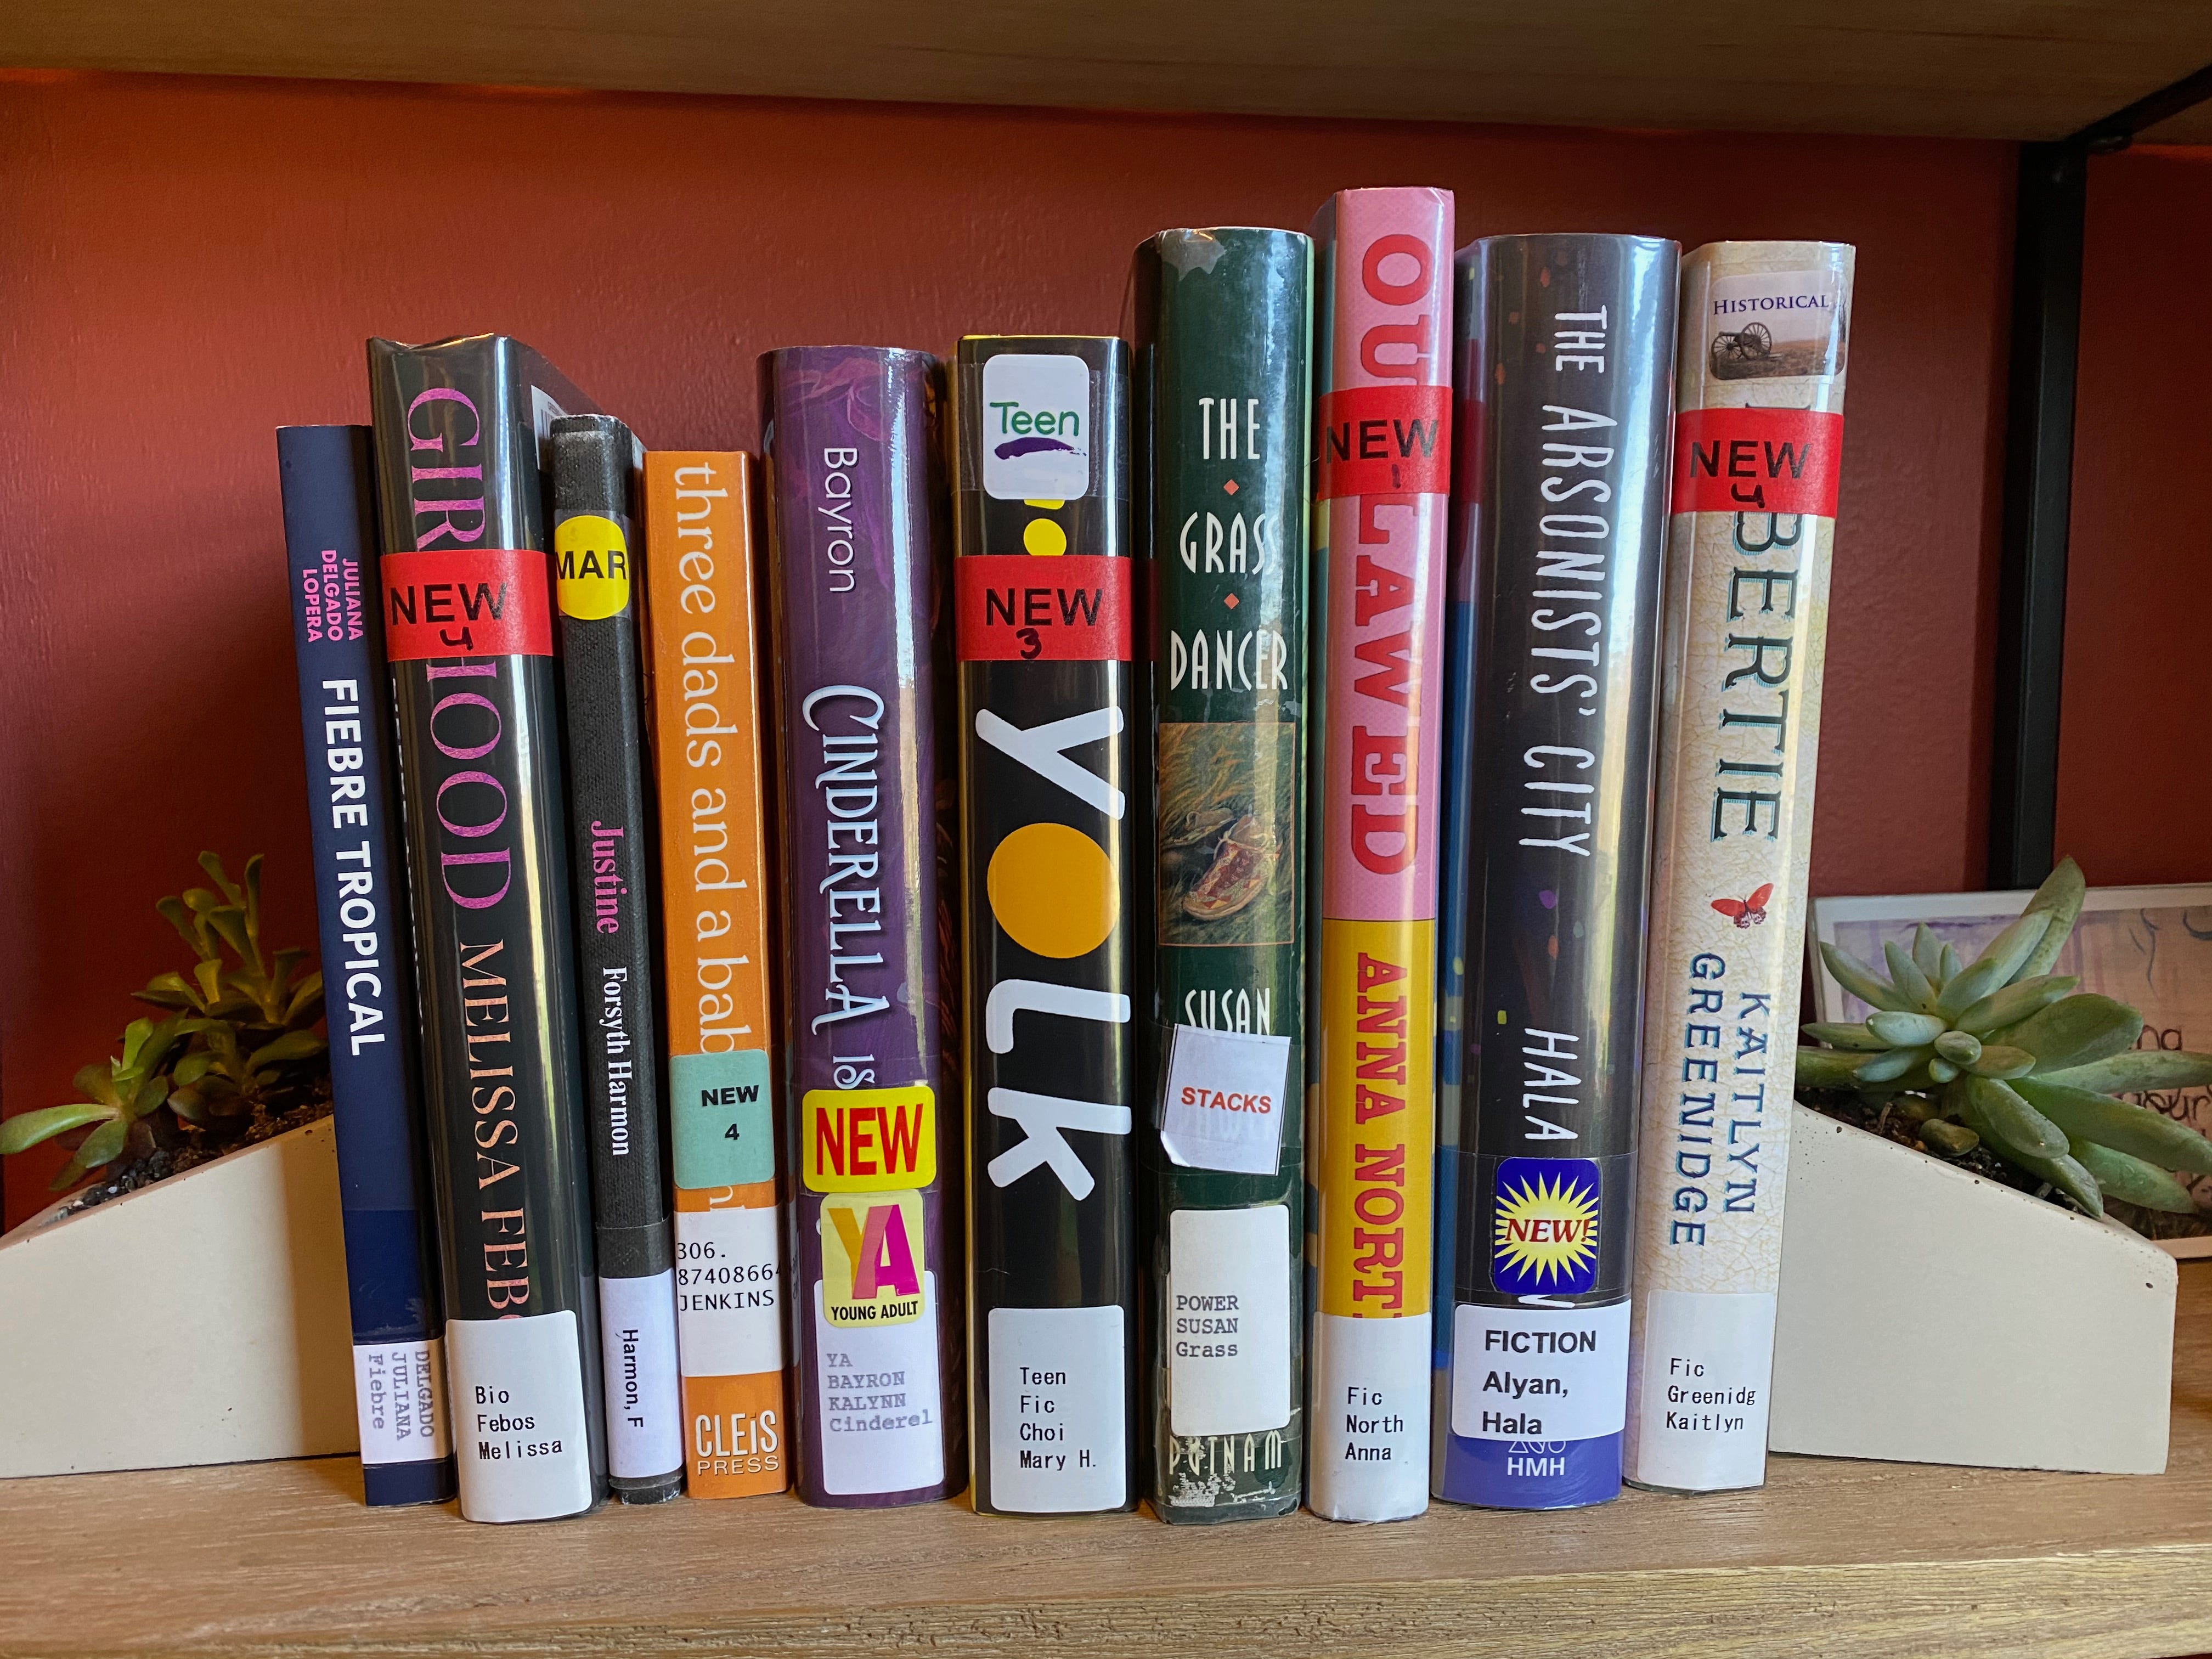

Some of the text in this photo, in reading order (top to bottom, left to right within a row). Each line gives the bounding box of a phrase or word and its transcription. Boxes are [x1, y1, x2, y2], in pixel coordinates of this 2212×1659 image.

[1554, 304, 1607, 374] THE
[990, 401, 1080, 436] Teen
[1199, 398, 1260, 460] THE
[1326, 419, 1438, 462] NEW
[1690, 439, 1811, 479] NEW
[818, 448, 857, 592] Bayron
[1180, 511, 1278, 574] GRASS
[1351, 234, 1434, 875] OULAWED
[555, 550, 628, 582] MAR
[303, 569, 323, 643] LOPERA
[321, 550, 343, 641] DELGADO
[342, 558, 364, 641] JULIANA
[391, 582, 507, 625] NEW
[986, 588, 1103, 627] NEW
[1711, 402, 1810, 842] BERTIE
[407, 388, 511, 909] GIROOD
[1015, 628, 1042, 659] 3
[1171, 629, 1288, 691] DANCER
[674, 462, 752, 1053] three dads and a bab
[1518, 744, 1595, 857] CITY
[322, 679, 386, 1056] FIEBRE TROPICAL
[590, 820, 628, 934] Justine
[802, 685, 890, 1036] CINDERELLA
[1184, 988, 1270, 1035] SUSAN
[599, 966, 632, 1156] Forsyth Harmon
[702, 1085, 759, 1107] NEW
[1521, 1026, 1580, 1141] HALA
[1670, 952, 1726, 1248] GREENIDGE
[1181, 1086, 1272, 1115] STACKS
[1722, 992, 1771, 1213] KAITLYN
[460, 939, 529, 1319] MELISSA FEB
[725, 1124, 740, 1141] 4
[816, 1103, 923, 1176] NEW
[1353, 952, 1408, 1318] ANNA NORT
[1505, 1218, 1592, 1243] NEW!
[678, 1242, 726, 1260] 306.
[827, 1204, 920, 1300] YA
[680, 1289, 774, 1311] JENKINS
[831, 1301, 919, 1322] YOUNG ADULT
[1177, 1295, 1239, 1311] POWER
[1177, 1318, 1238, 1334] SUSAN
[1485, 1330, 1596, 1354] FICTION
[826, 1353, 853, 1368] YA
[1176, 1341, 1238, 1357] Grass
[622, 1329, 644, 1427] Harmon, F
[827, 1372, 905, 1389] BAYRON
[1020, 1367, 1066, 1385] Teen
[1670, 1357, 1704, 1376] Fic
[369, 1353, 384, 1430] Fiebre
[392, 1352, 411, 1440] JULIANA
[415, 1351, 434, 1437] DELGADO
[475, 1386, 509, 1404] Bio
[1348, 1386, 1382, 1406] Fic
[1482, 1372, 1568, 1398] Alyan,
[1668, 1385, 1756, 1406] Greenidg
[828, 1393, 906, 1411] KALYNN
[1020, 1396, 1055, 1413] Fic
[478, 1414, 535, 1432] Febos
[830, 1409, 933, 1432] Cinderel
[1020, 1424, 1064, 1441] Choi
[1346, 1415, 1403, 1433] North
[1482, 1412, 1542, 1435] Hala
[1666, 1412, 1744, 1432] Kaitlyn
[478, 1440, 563, 1460] Melissa
[697, 1455, 780, 1476] PRESS
[1020, 1449, 1097, 1471] Mary H.
[1345, 1442, 1392, 1460] Anna
[1507, 1457, 1565, 1477] HMH
